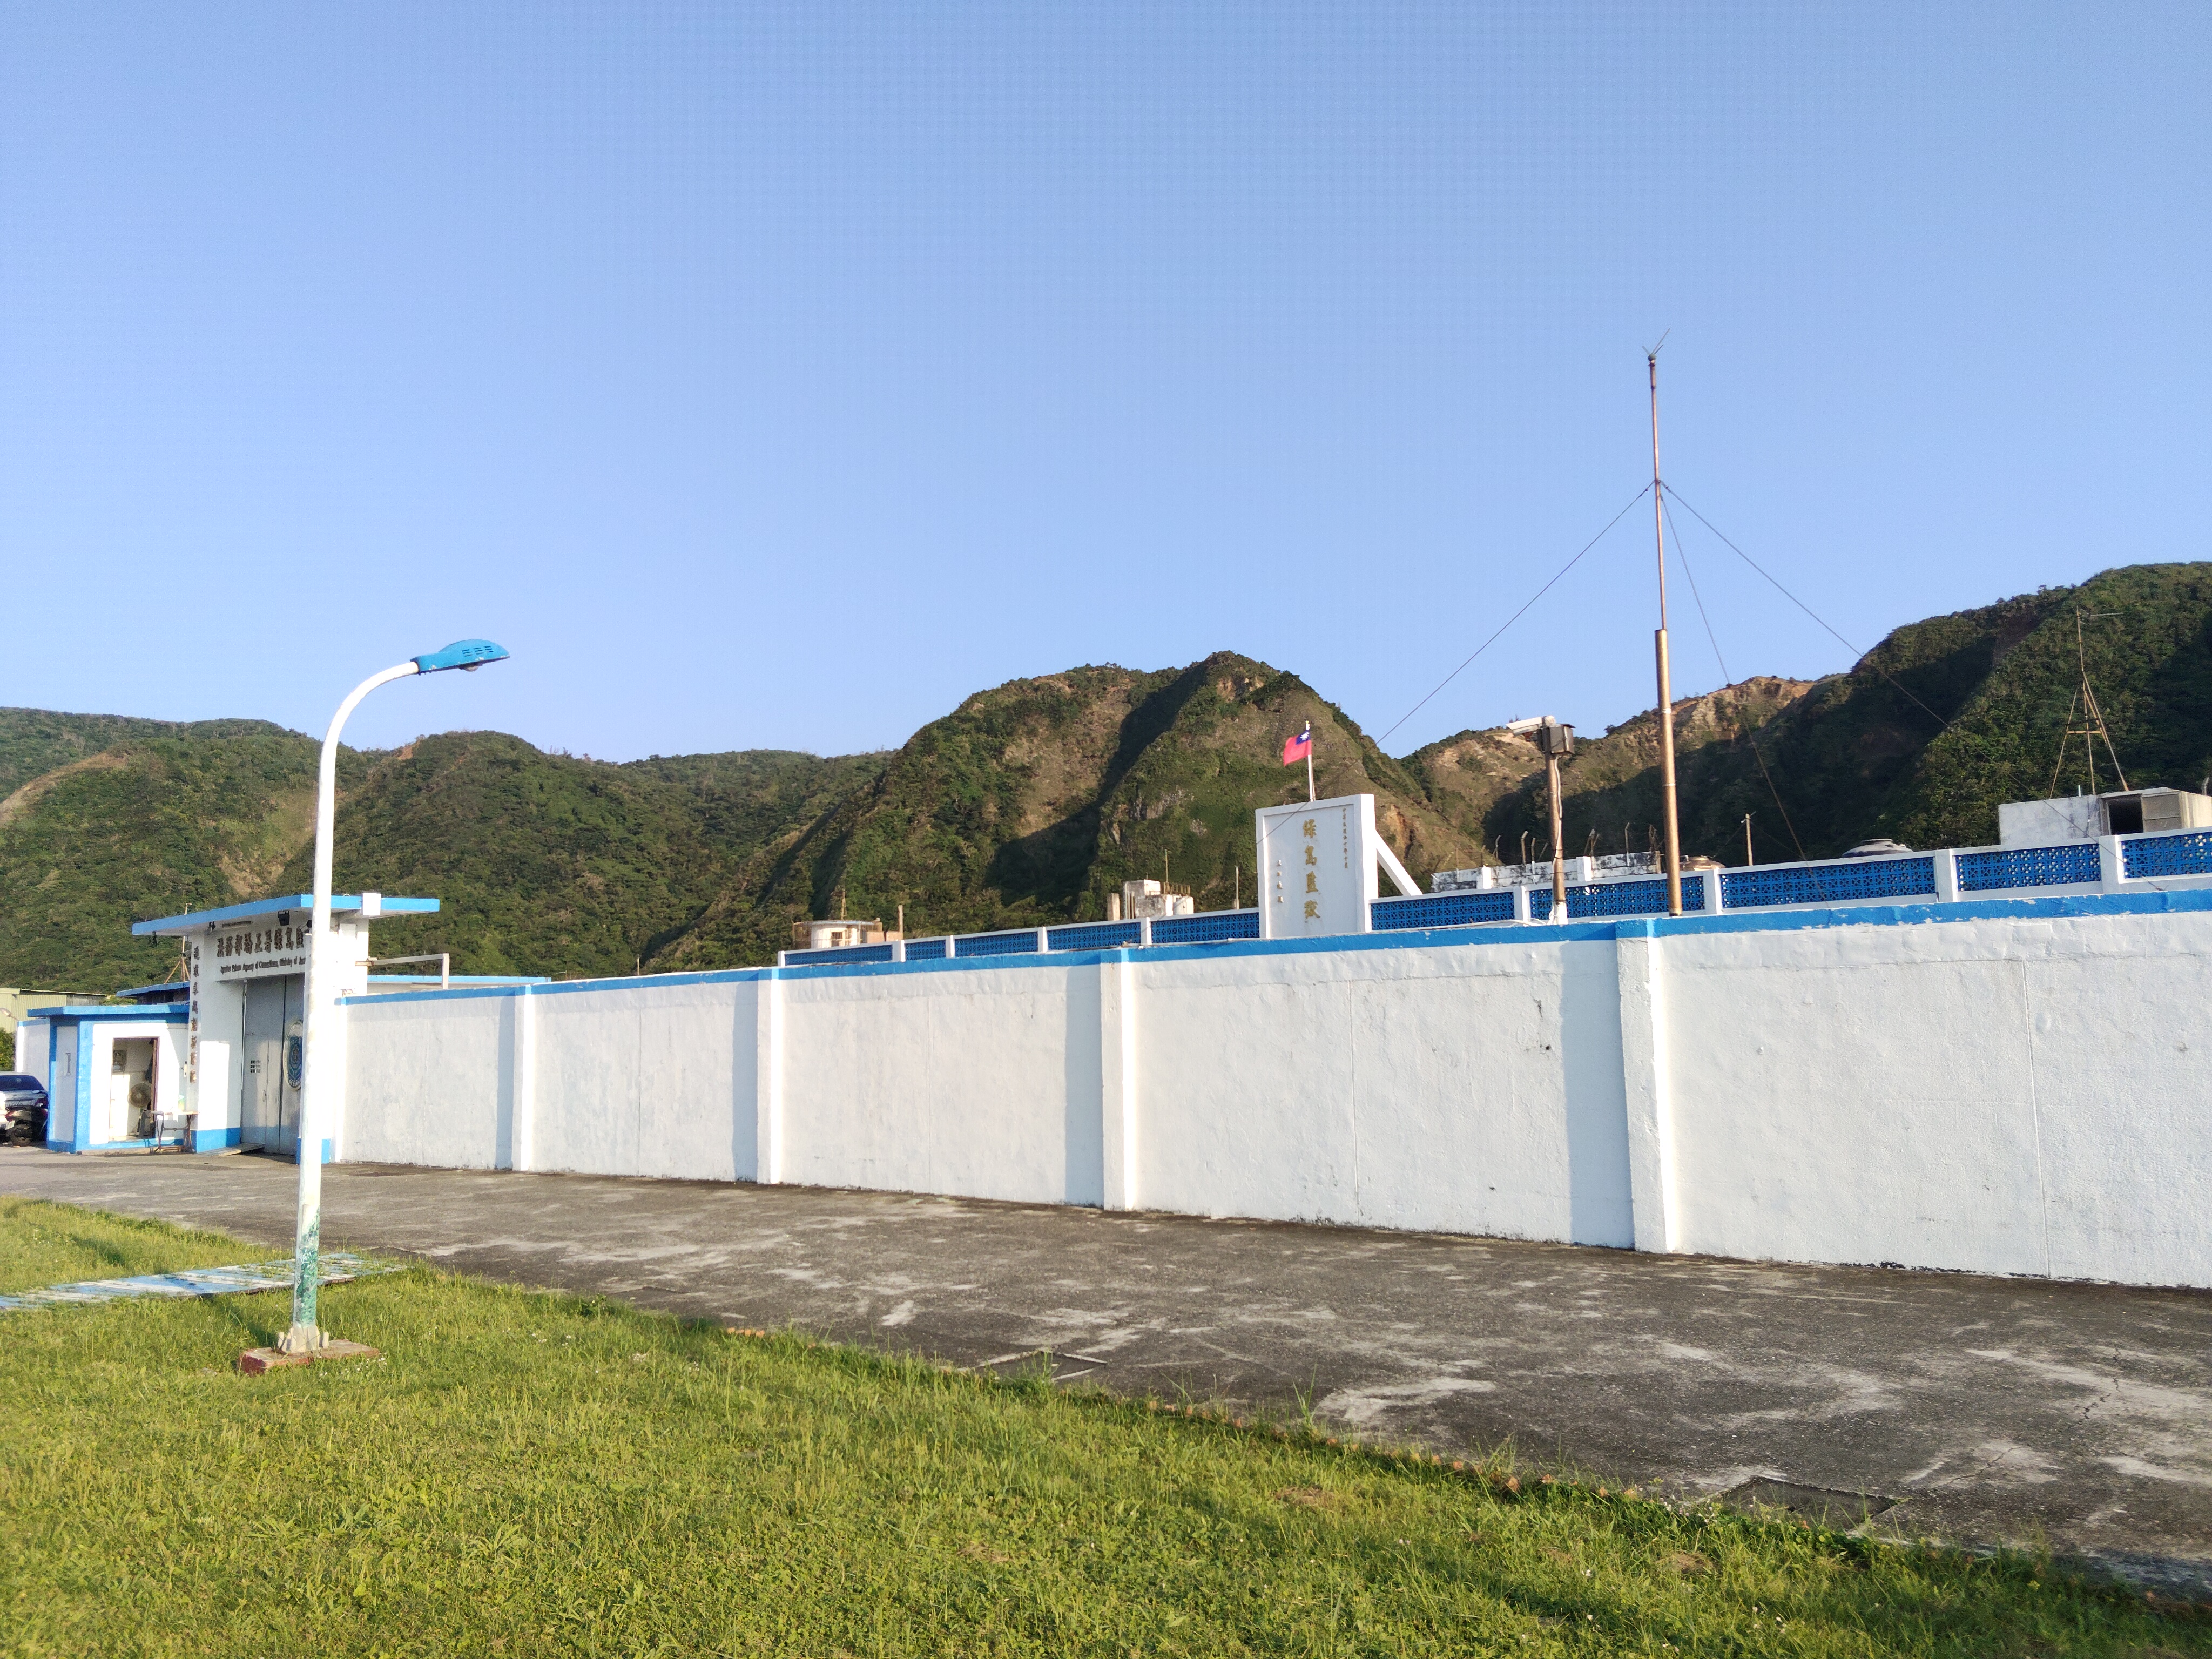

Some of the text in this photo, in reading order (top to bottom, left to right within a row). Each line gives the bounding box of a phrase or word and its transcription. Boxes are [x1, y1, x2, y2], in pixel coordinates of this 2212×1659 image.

[217, 926, 304, 957] 法務部矯正署綠島監
[254, 961, 259, 969] of
[293, 956, 297, 965] of
